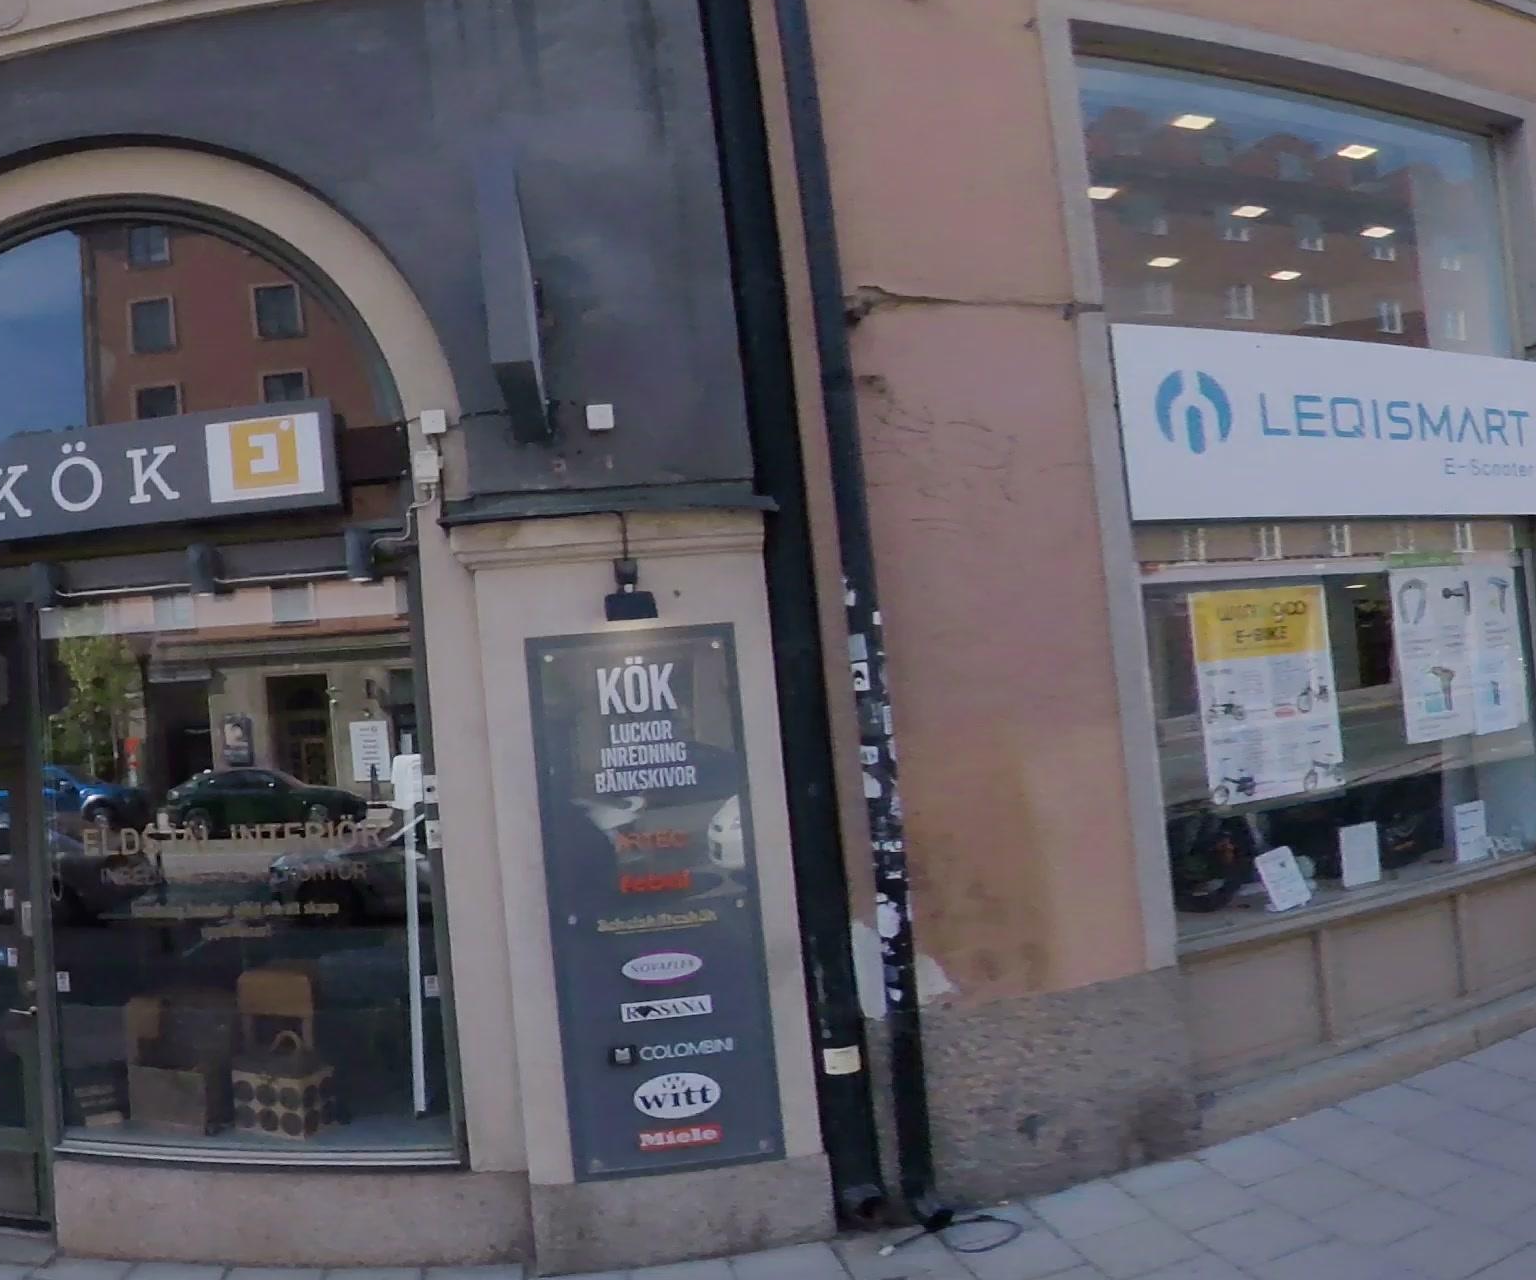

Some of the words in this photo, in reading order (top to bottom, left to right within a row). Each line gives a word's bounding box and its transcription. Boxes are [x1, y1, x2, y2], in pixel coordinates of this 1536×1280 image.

[1259, 393, 1530, 448] LEQISMART
[596, 656, 678, 715] KÖK
[610, 720, 673, 745] LUCKOR
[600, 741, 687, 769] INREDNING
[594, 765, 698, 794] BÄNKSKIVOR
[639, 1037, 734, 1061] COLOMBINI
[638, 1083, 713, 1111] witt
[639, 1127, 719, 1147] Miele
